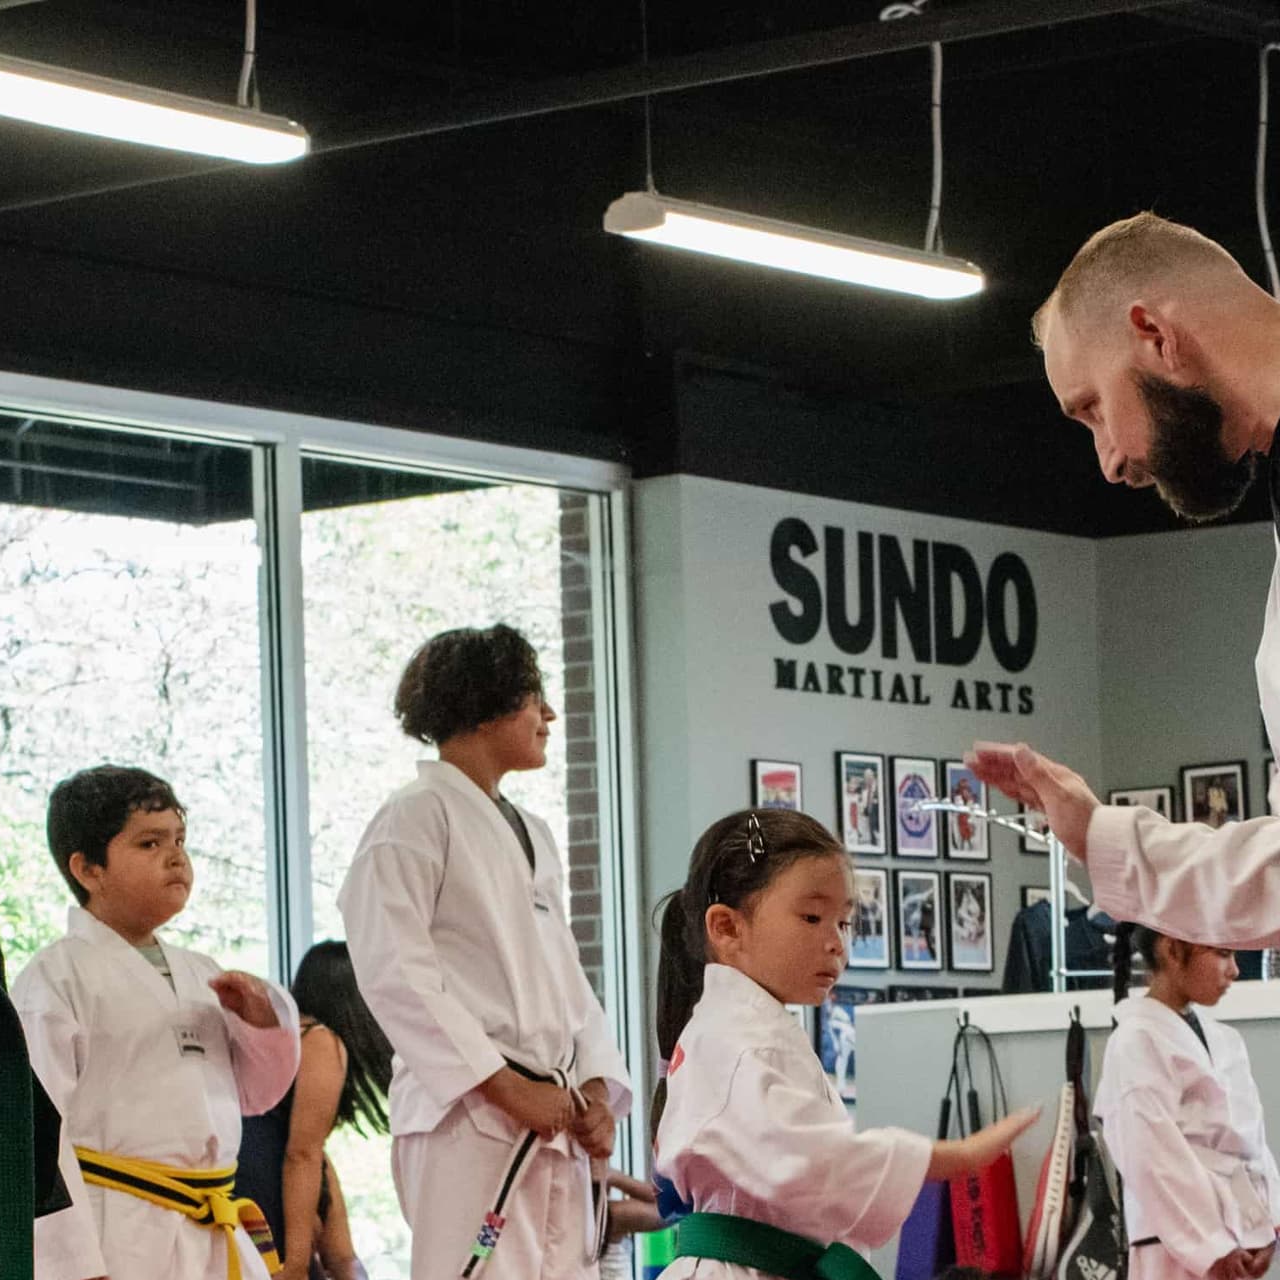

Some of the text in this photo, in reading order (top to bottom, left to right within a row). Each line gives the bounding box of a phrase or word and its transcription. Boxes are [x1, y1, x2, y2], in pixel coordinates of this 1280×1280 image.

[769, 517, 1038, 674] SUNDO
[774, 658, 1035, 715] MARTIAL ARTS
